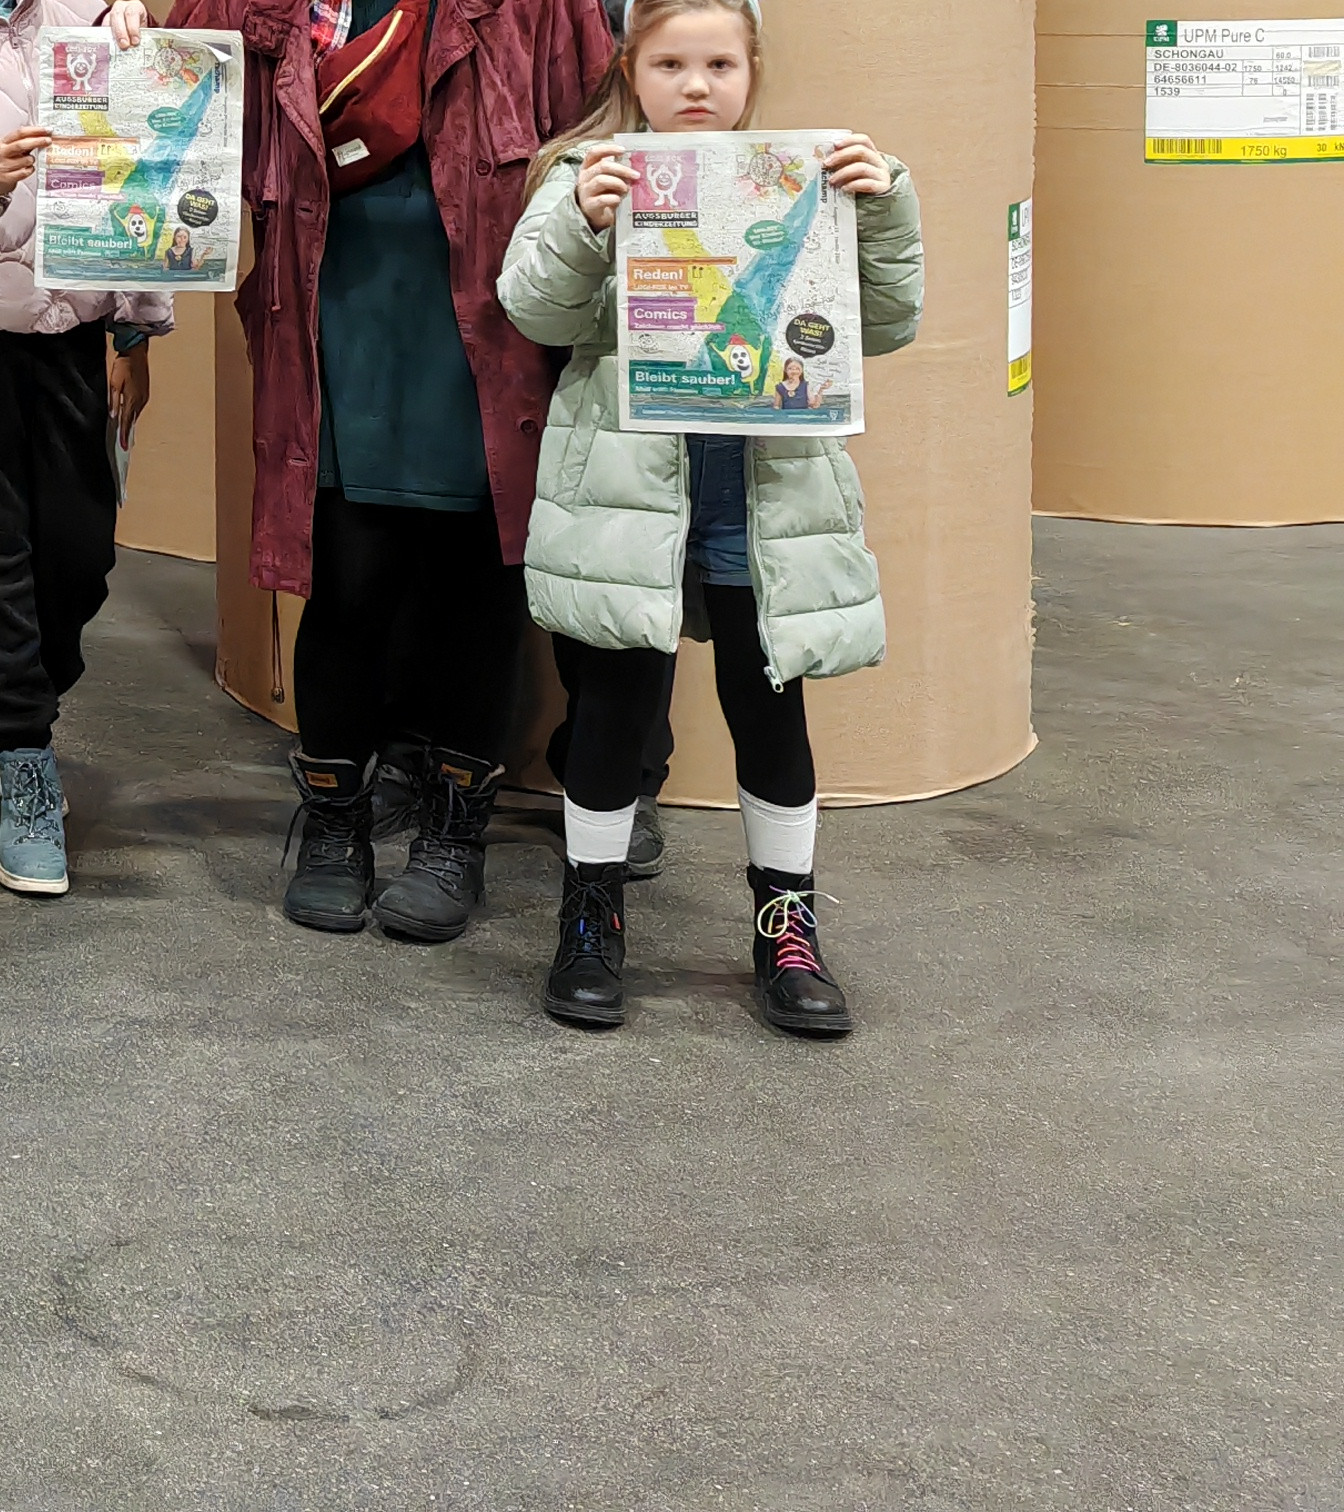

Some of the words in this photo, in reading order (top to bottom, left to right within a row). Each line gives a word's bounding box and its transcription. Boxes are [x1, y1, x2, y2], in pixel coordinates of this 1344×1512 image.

[1183, 29, 1218, 44] UPM
[1222, 30, 1251, 43] Pure
[1255, 28, 1265, 43] C
[1154, 49, 1224, 59] SCHONGAU
[1154, 62, 1237, 72] DE-8036044-02
[1154, 87, 1180, 96] 1539
[1241, 145, 1270, 157] 1750
[1274, 144, 1288, 158] kg
[1316, 143, 1327, 152] 30
[49, 235, 84, 246] Bleibt
[87, 236, 132, 249] sauber!
[633, 269, 683, 280] Reden!
[634, 308, 688, 320] Comics
[635, 371, 677, 382] Bleibt
[681, 374, 735, 385] sauber!
